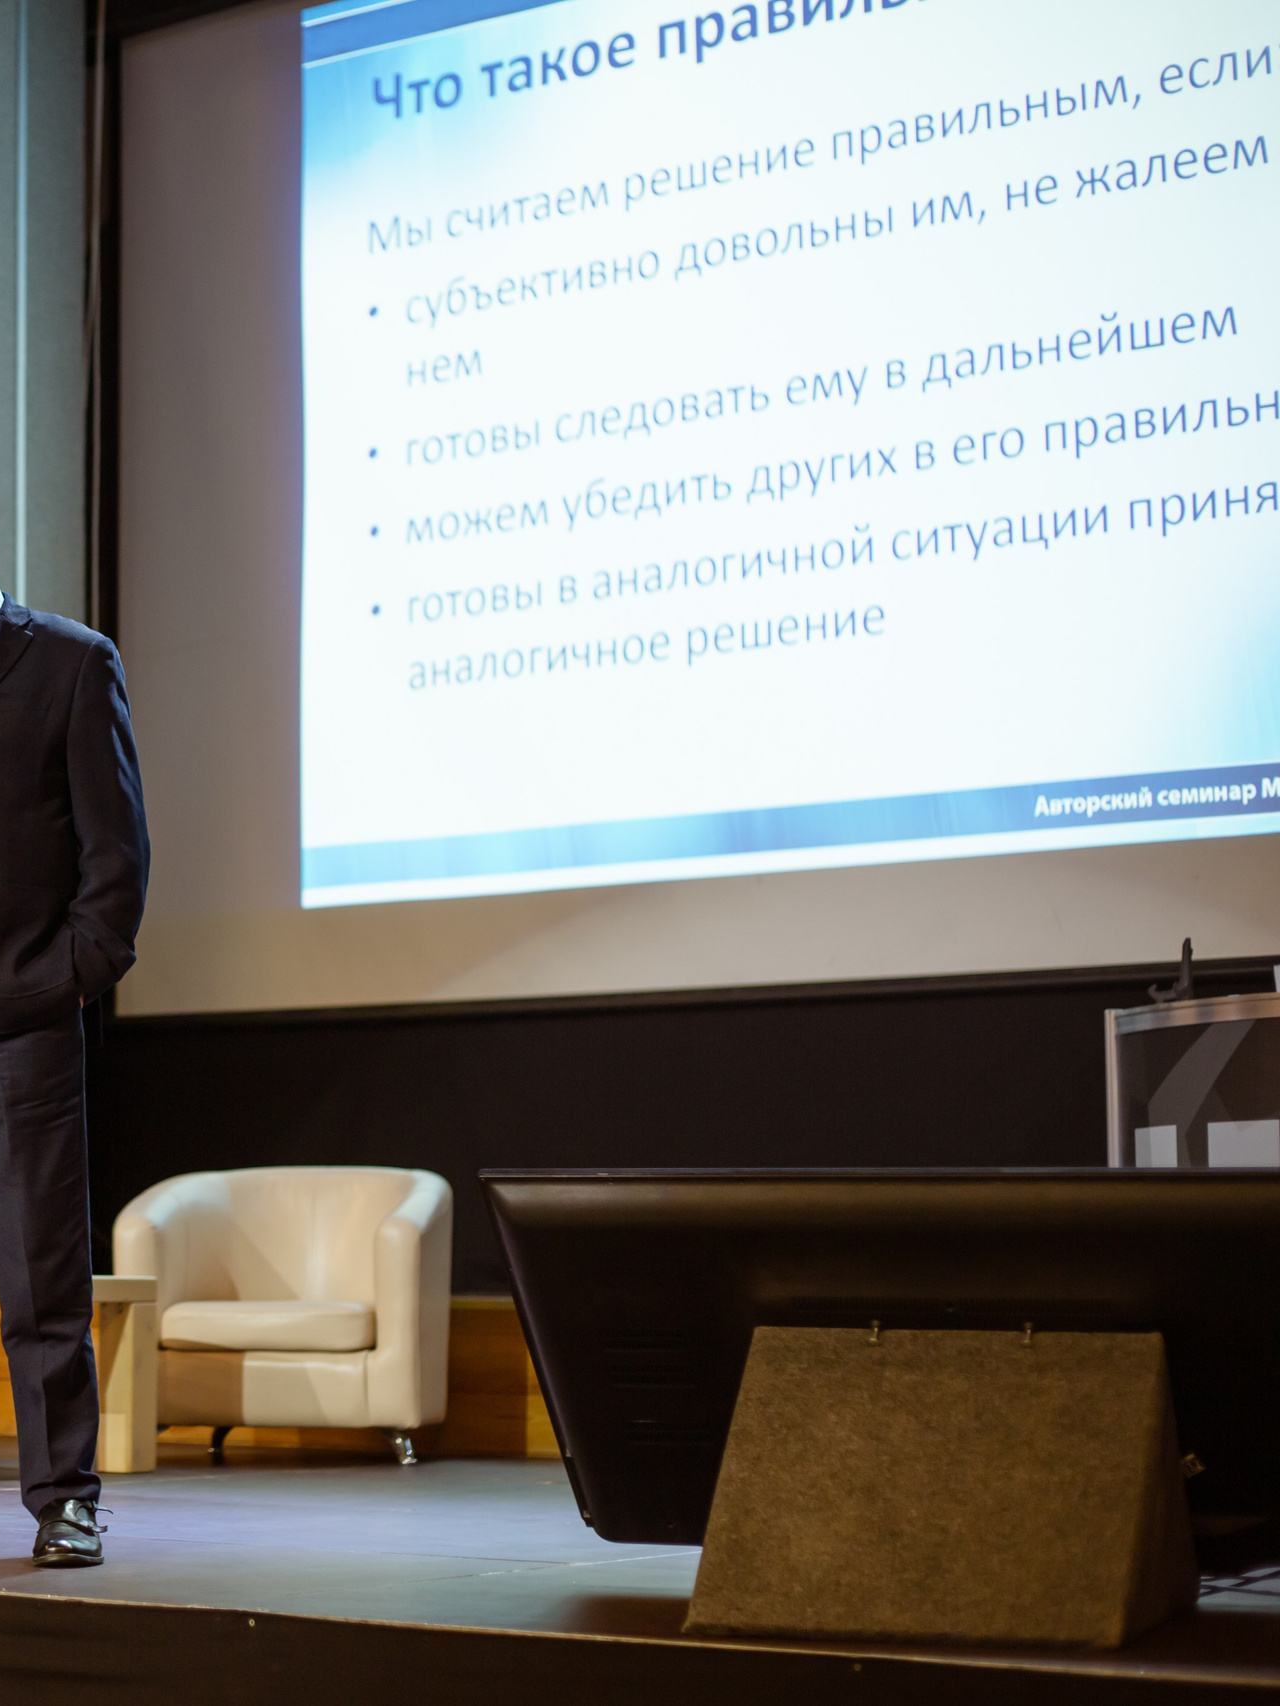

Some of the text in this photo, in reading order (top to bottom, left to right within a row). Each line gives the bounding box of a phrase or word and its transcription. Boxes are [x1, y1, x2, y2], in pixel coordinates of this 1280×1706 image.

[373, 71, 463, 118] Что
[480, 33, 636, 98] такое
[368, 216, 432, 254] Мы
[446, 181, 609, 238] считаем
[624, 138, 816, 210] решение
[832, 75, 1141, 165] правильным,
[407, 135, 1269, 327] субъективно довольны им, не жалеем
[407, 349, 483, 386] нем
[407, 306, 1238, 465] готовы следовать ему в дальнейшем
[407, 390, 1280, 545] можем убедить других в его правильн
[407, 481, 1279, 623] готовы в аналогичной ситуации приня
[409, 604, 886, 690] аналогичное решение
[1034, 785, 1153, 818] Авторский
[1157, 783, 1257, 806] семинар
